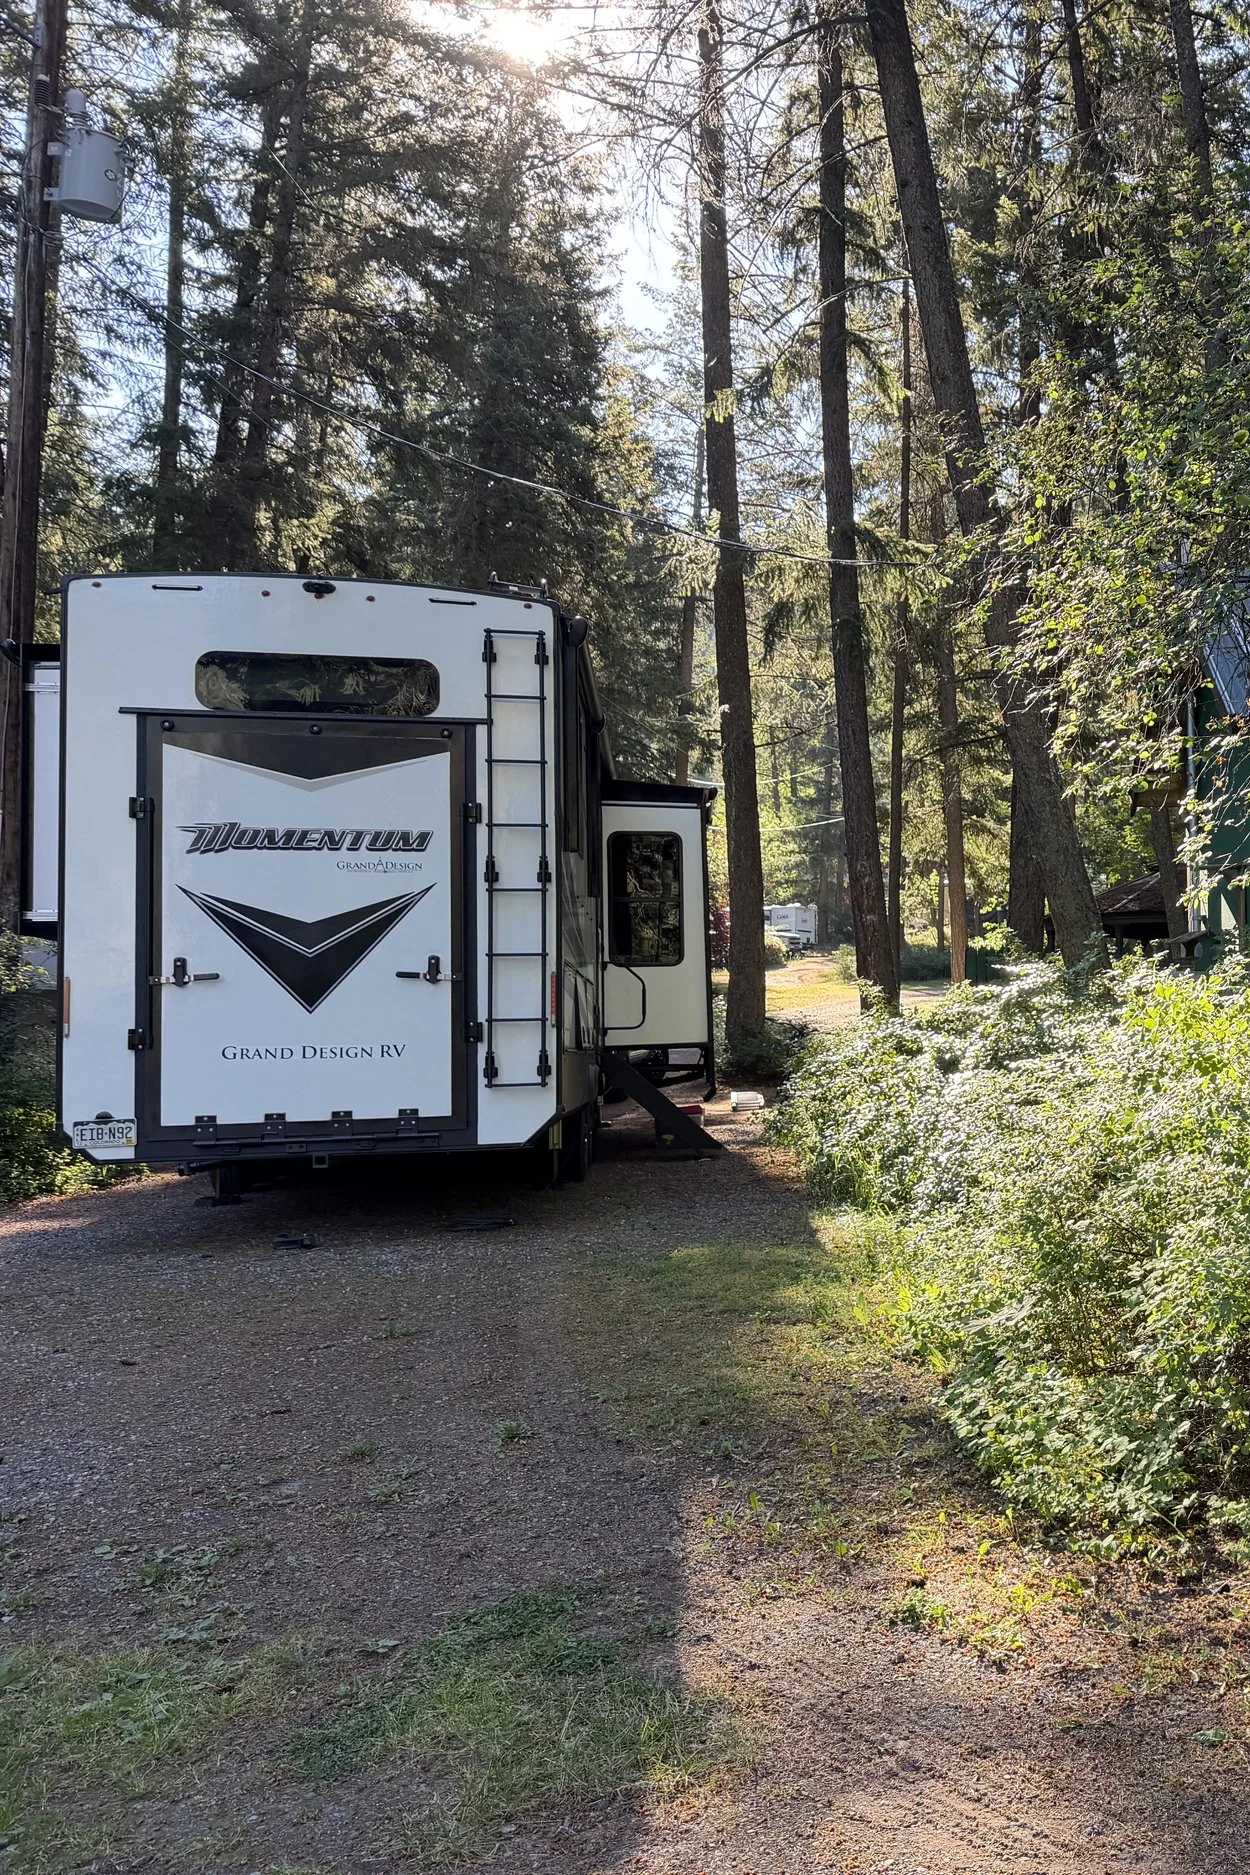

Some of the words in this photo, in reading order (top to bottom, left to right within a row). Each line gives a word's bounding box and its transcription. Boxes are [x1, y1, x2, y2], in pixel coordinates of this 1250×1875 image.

[176, 822, 434, 854] MOMENTUM
[336, 861, 376, 870] GRAND
[385, 861, 423, 871] DESIGN
[221, 1045, 294, 1060] GRAND
[302, 1045, 373, 1060] DESIGN
[380, 1044, 406, 1058] RV
